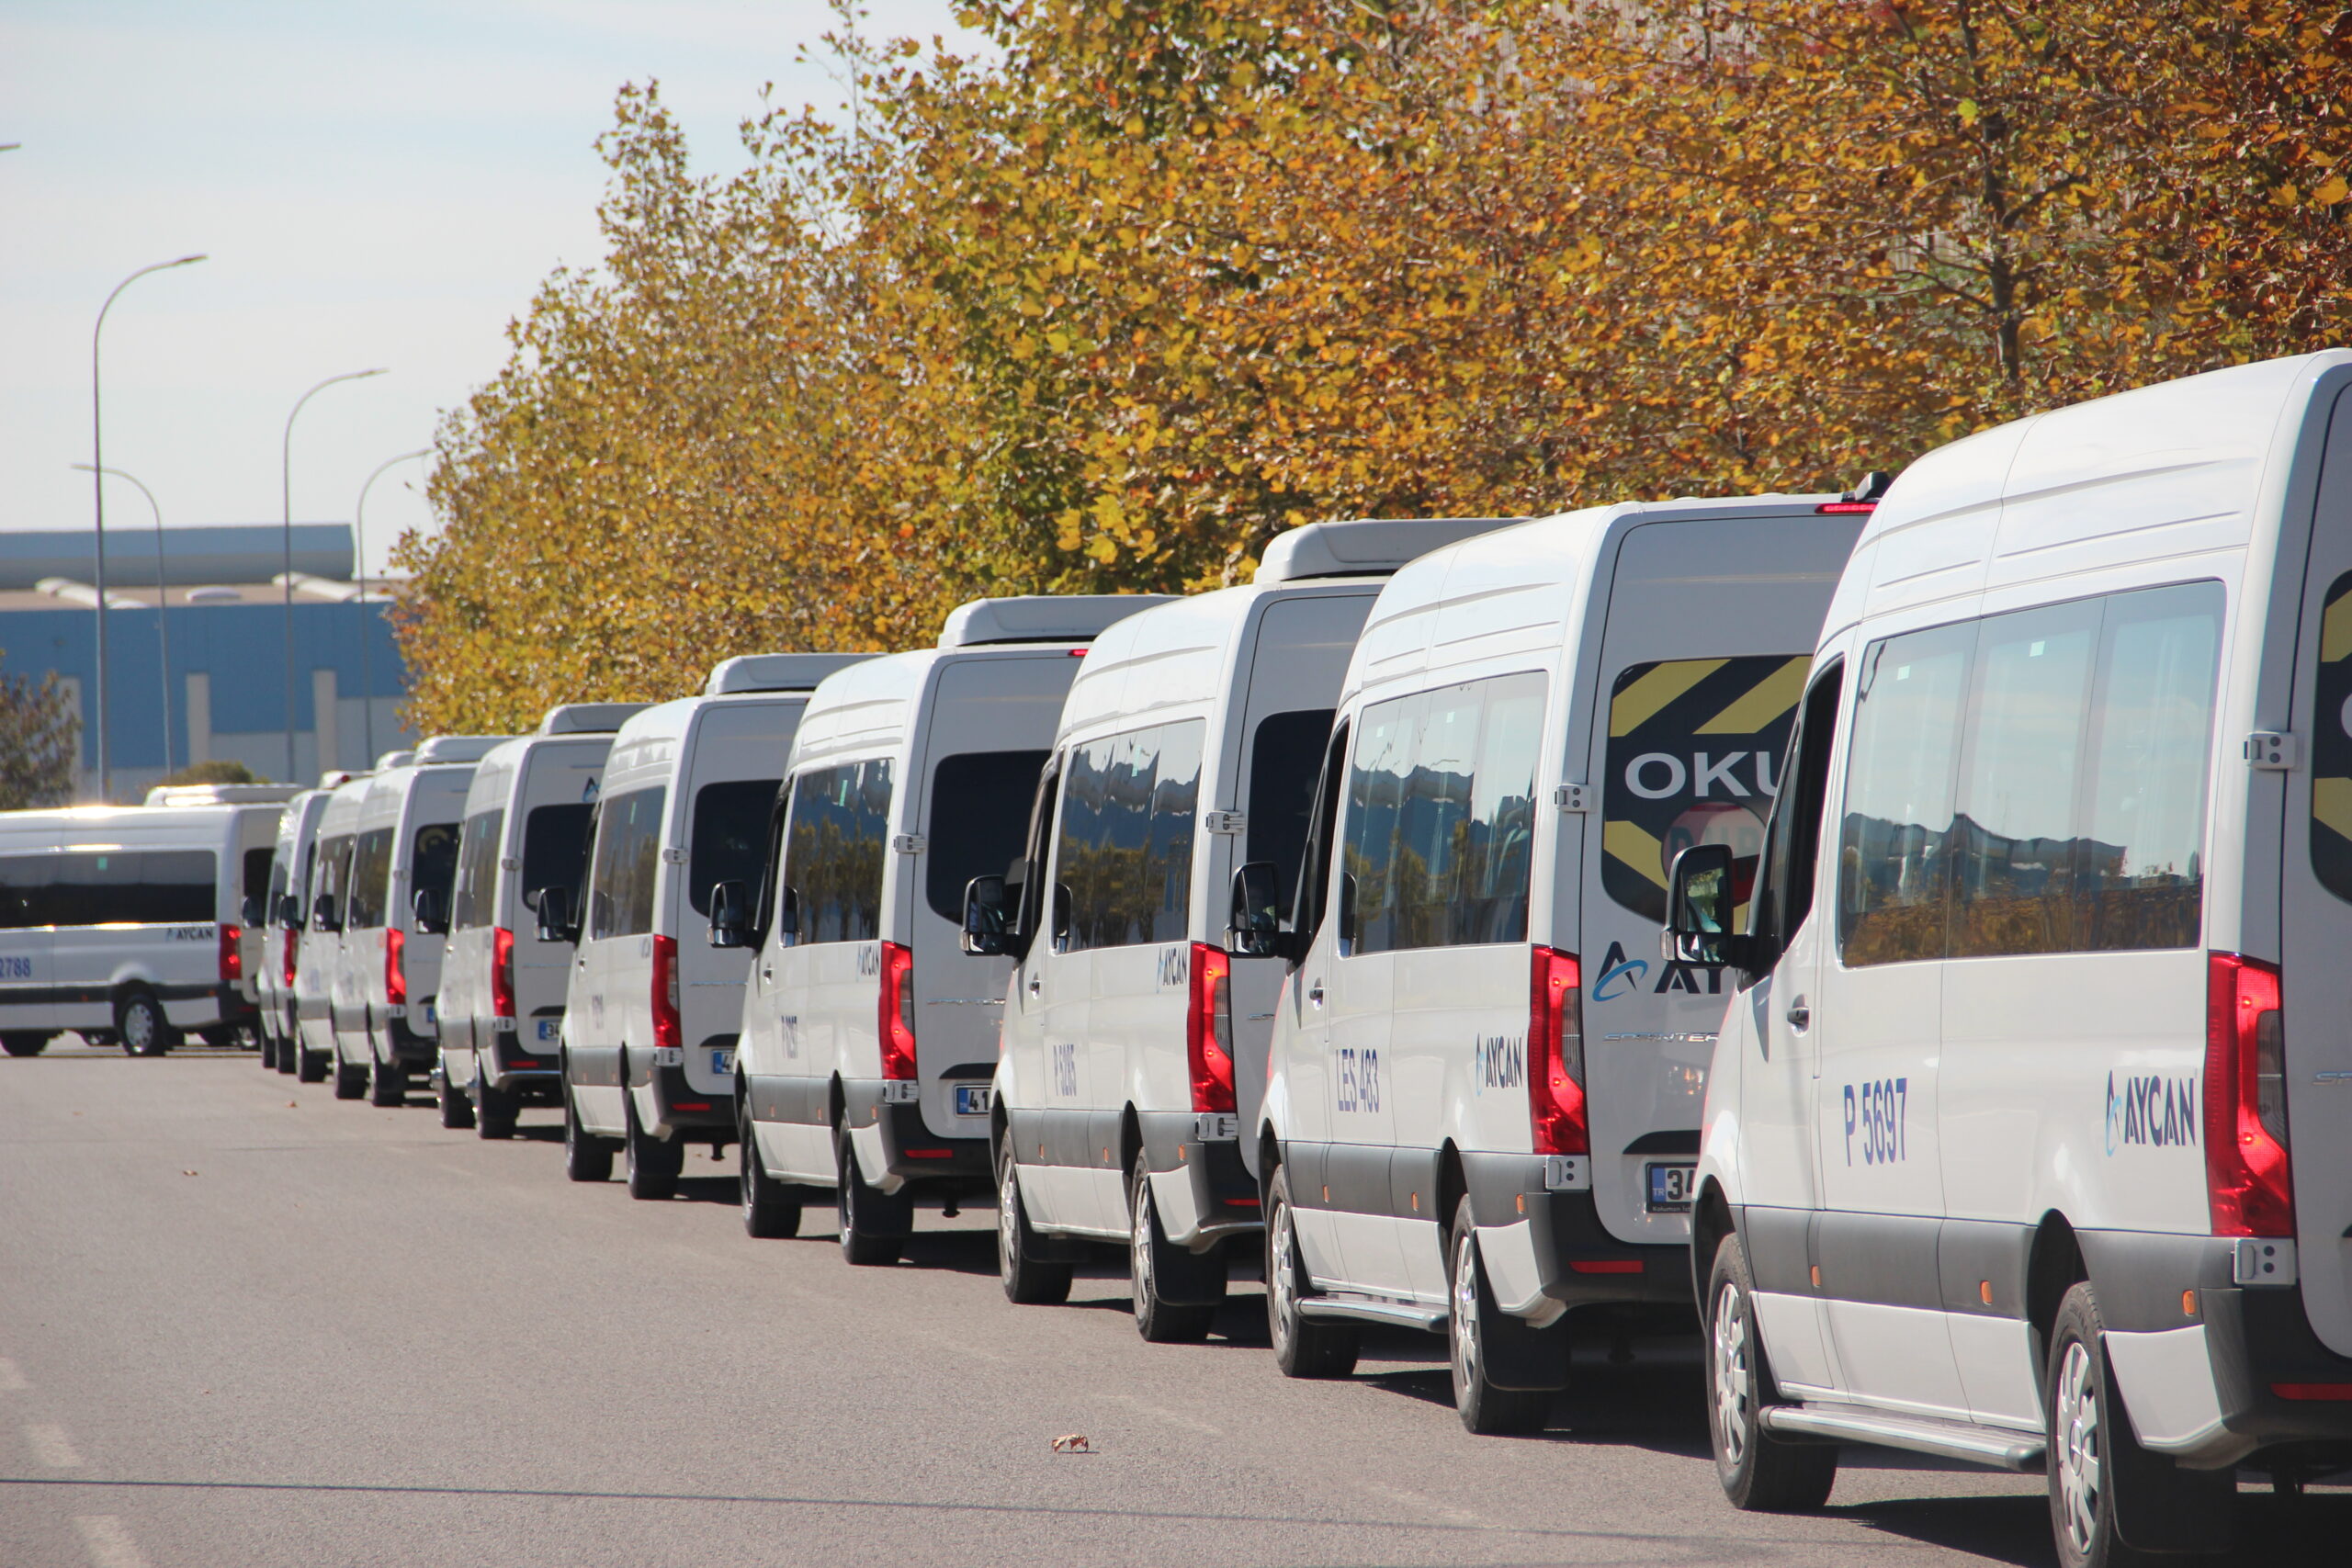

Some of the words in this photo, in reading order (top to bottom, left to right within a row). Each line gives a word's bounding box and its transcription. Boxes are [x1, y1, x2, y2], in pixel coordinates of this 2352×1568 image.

[175, 927, 214, 942] AYCAN
[1336, 1048, 1358, 1113] LES
[1360, 1048, 1380, 1113] 483
[1486, 1035, 1523, 1089] AYCAN
[968, 1090, 989, 1111] 41
[1844, 1084, 1856, 1168] P
[1862, 1077, 1908, 1166] 5697
[2124, 1075, 2197, 1147] AYCAN
